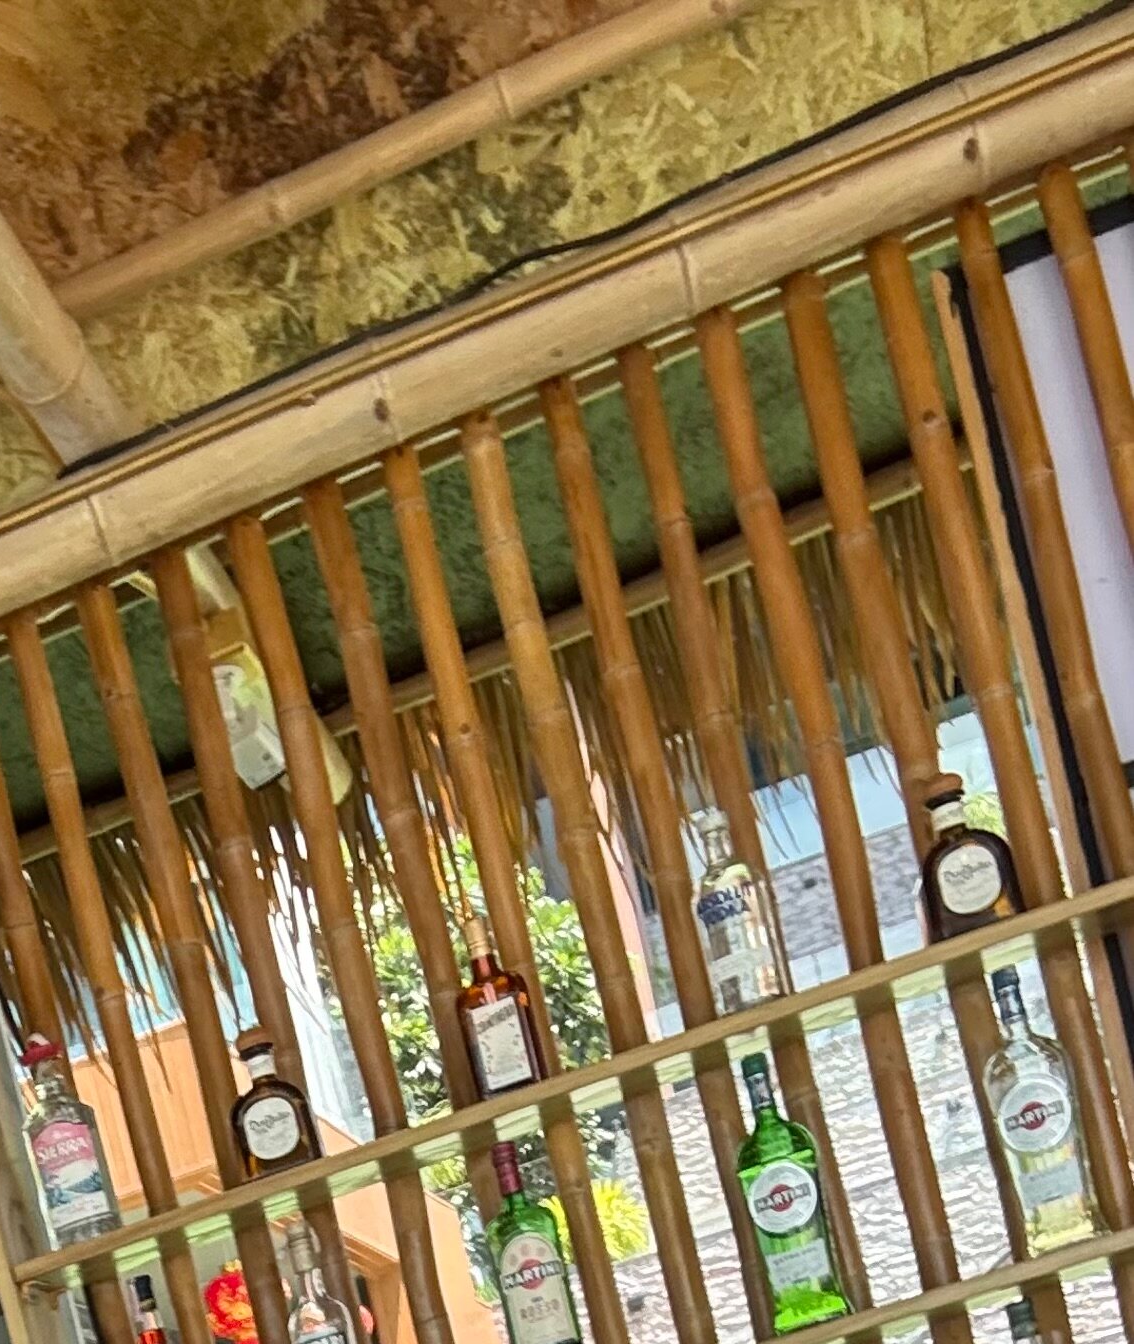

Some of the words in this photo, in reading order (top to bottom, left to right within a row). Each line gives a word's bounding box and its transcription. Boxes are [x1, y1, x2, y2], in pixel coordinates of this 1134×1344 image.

[1006, 1101, 1063, 1131] MARTINI
[36, 1137, 89, 1166] SIERRA
[756, 1184, 810, 1211] MARTINI
[503, 1262, 561, 1289] MARTINI
